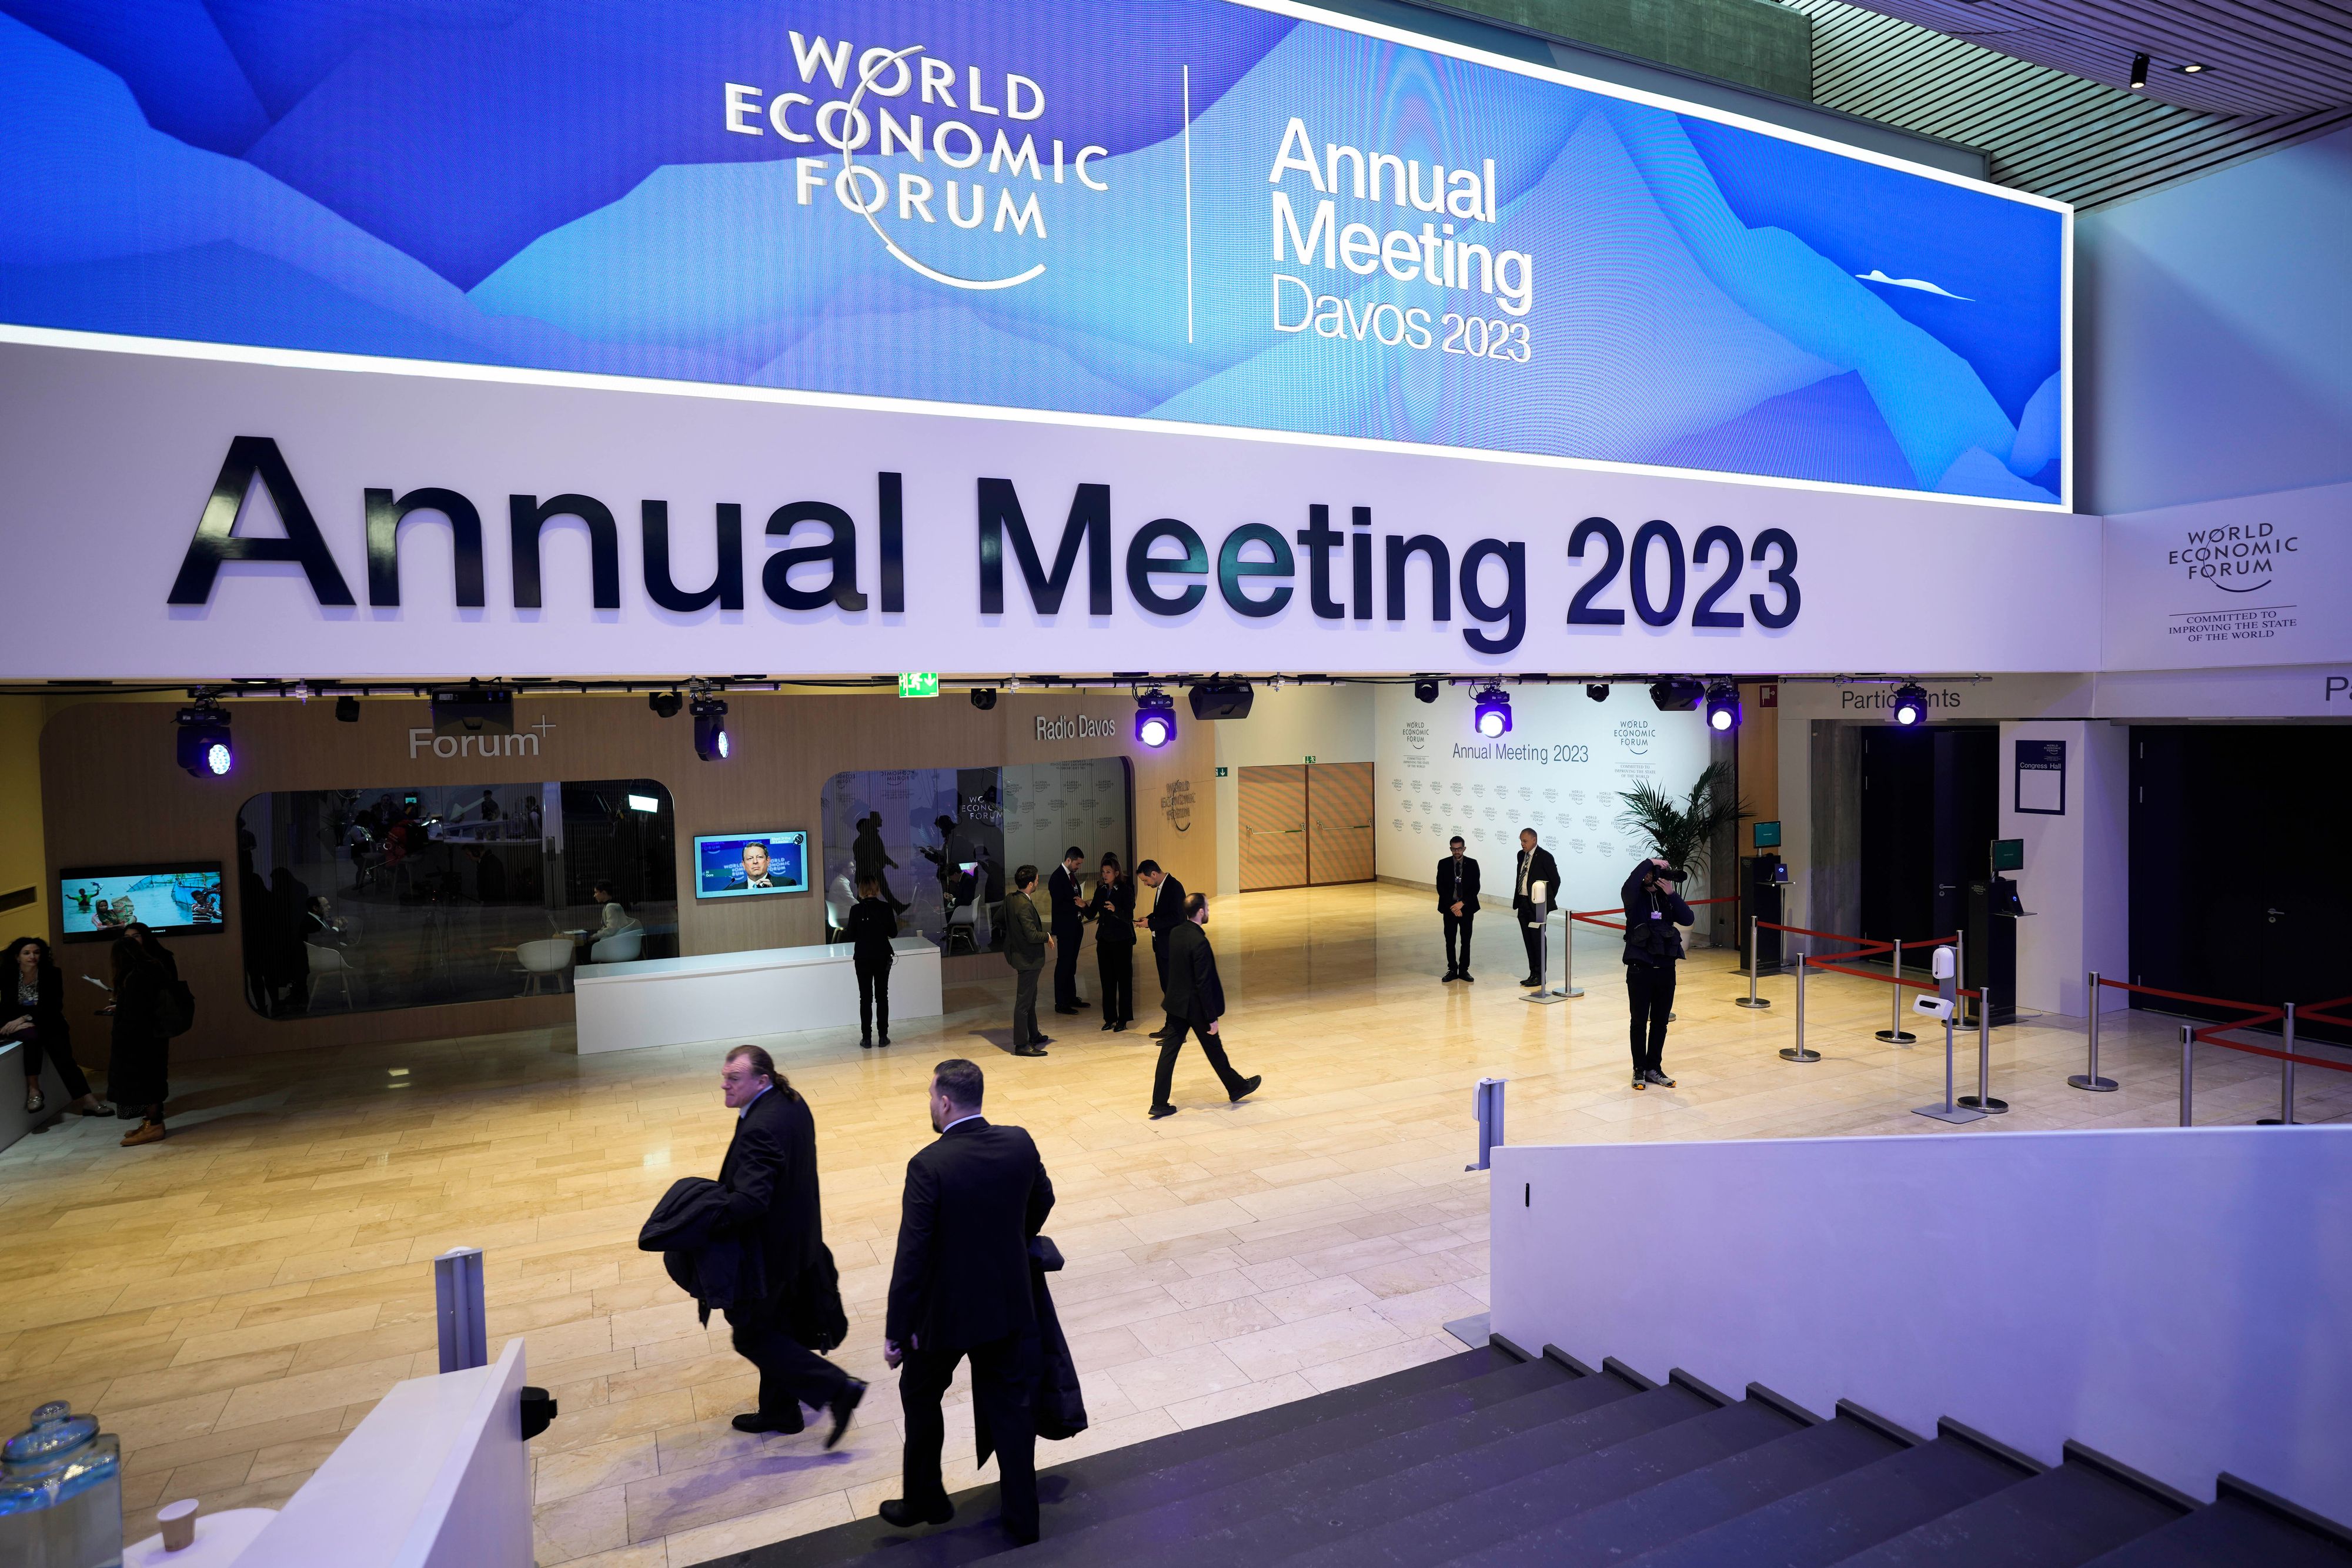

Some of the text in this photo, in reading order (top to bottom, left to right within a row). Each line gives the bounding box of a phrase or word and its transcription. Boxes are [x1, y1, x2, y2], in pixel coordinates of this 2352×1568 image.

[789, 30, 1046, 121] WORLD
[725, 82, 1109, 191] ECONOMIC
[1269, 117, 1496, 223] Annual
[797, 156, 1047, 239] FORUM
[1272, 191, 1532, 316] Meeting
[1273, 273, 1532, 363] Davos 2023
[166, 436, 1800, 654] Annual Meeting 2023
[2188, 523, 2274, 545] WORLD
[2169, 537, 2298, 564] ECONOMIC
[2189, 558, 2273, 579] FORUM
[2169, 618, 2297, 634] IMPROVING THE STATE
[2187, 611, 2276, 624] COMMITTED TO
[2188, 630, 2274, 642] OF THE WORLD
[1842, 689, 1961, 709] Particnts
[2326, 677, 2352, 701] P
[1037, 714, 1115, 741] Radio Davos
[1452, 743, 1589, 764] Annual Meeting 2023
[970, 811, 1003, 820] FORUM
